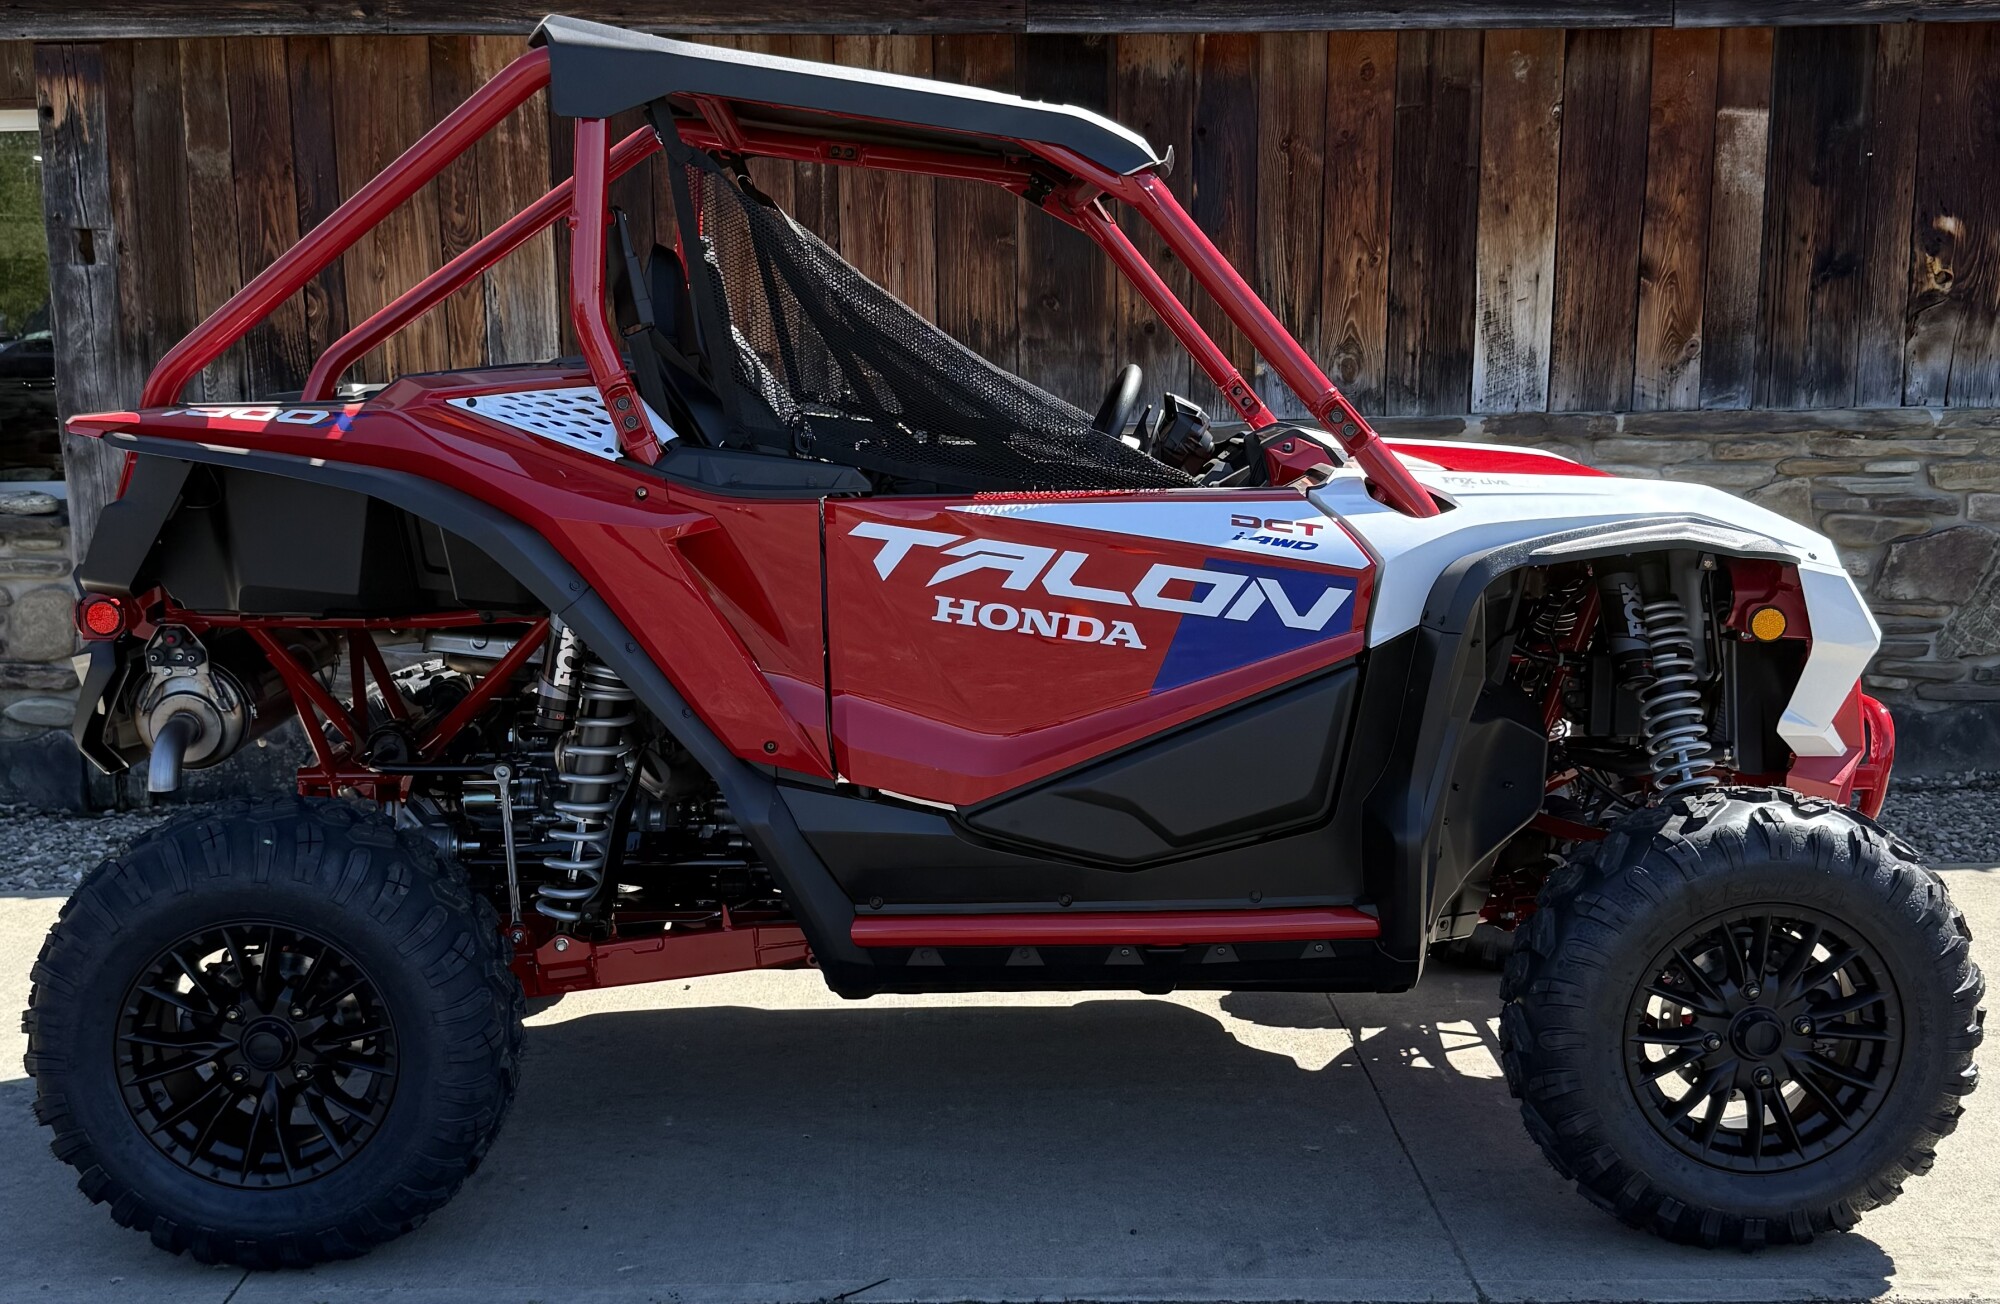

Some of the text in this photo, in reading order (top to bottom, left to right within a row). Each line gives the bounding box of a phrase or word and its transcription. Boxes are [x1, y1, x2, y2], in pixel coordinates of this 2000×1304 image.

[1231, 514, 1323, 536] DCT
[1232, 532, 1319, 550] i-4WD
[848, 521, 1353, 631] TALON
[931, 596, 1146, 650] HONDA
[1619, 583, 1648, 638] FOX
[554, 626, 582, 687] FOX
